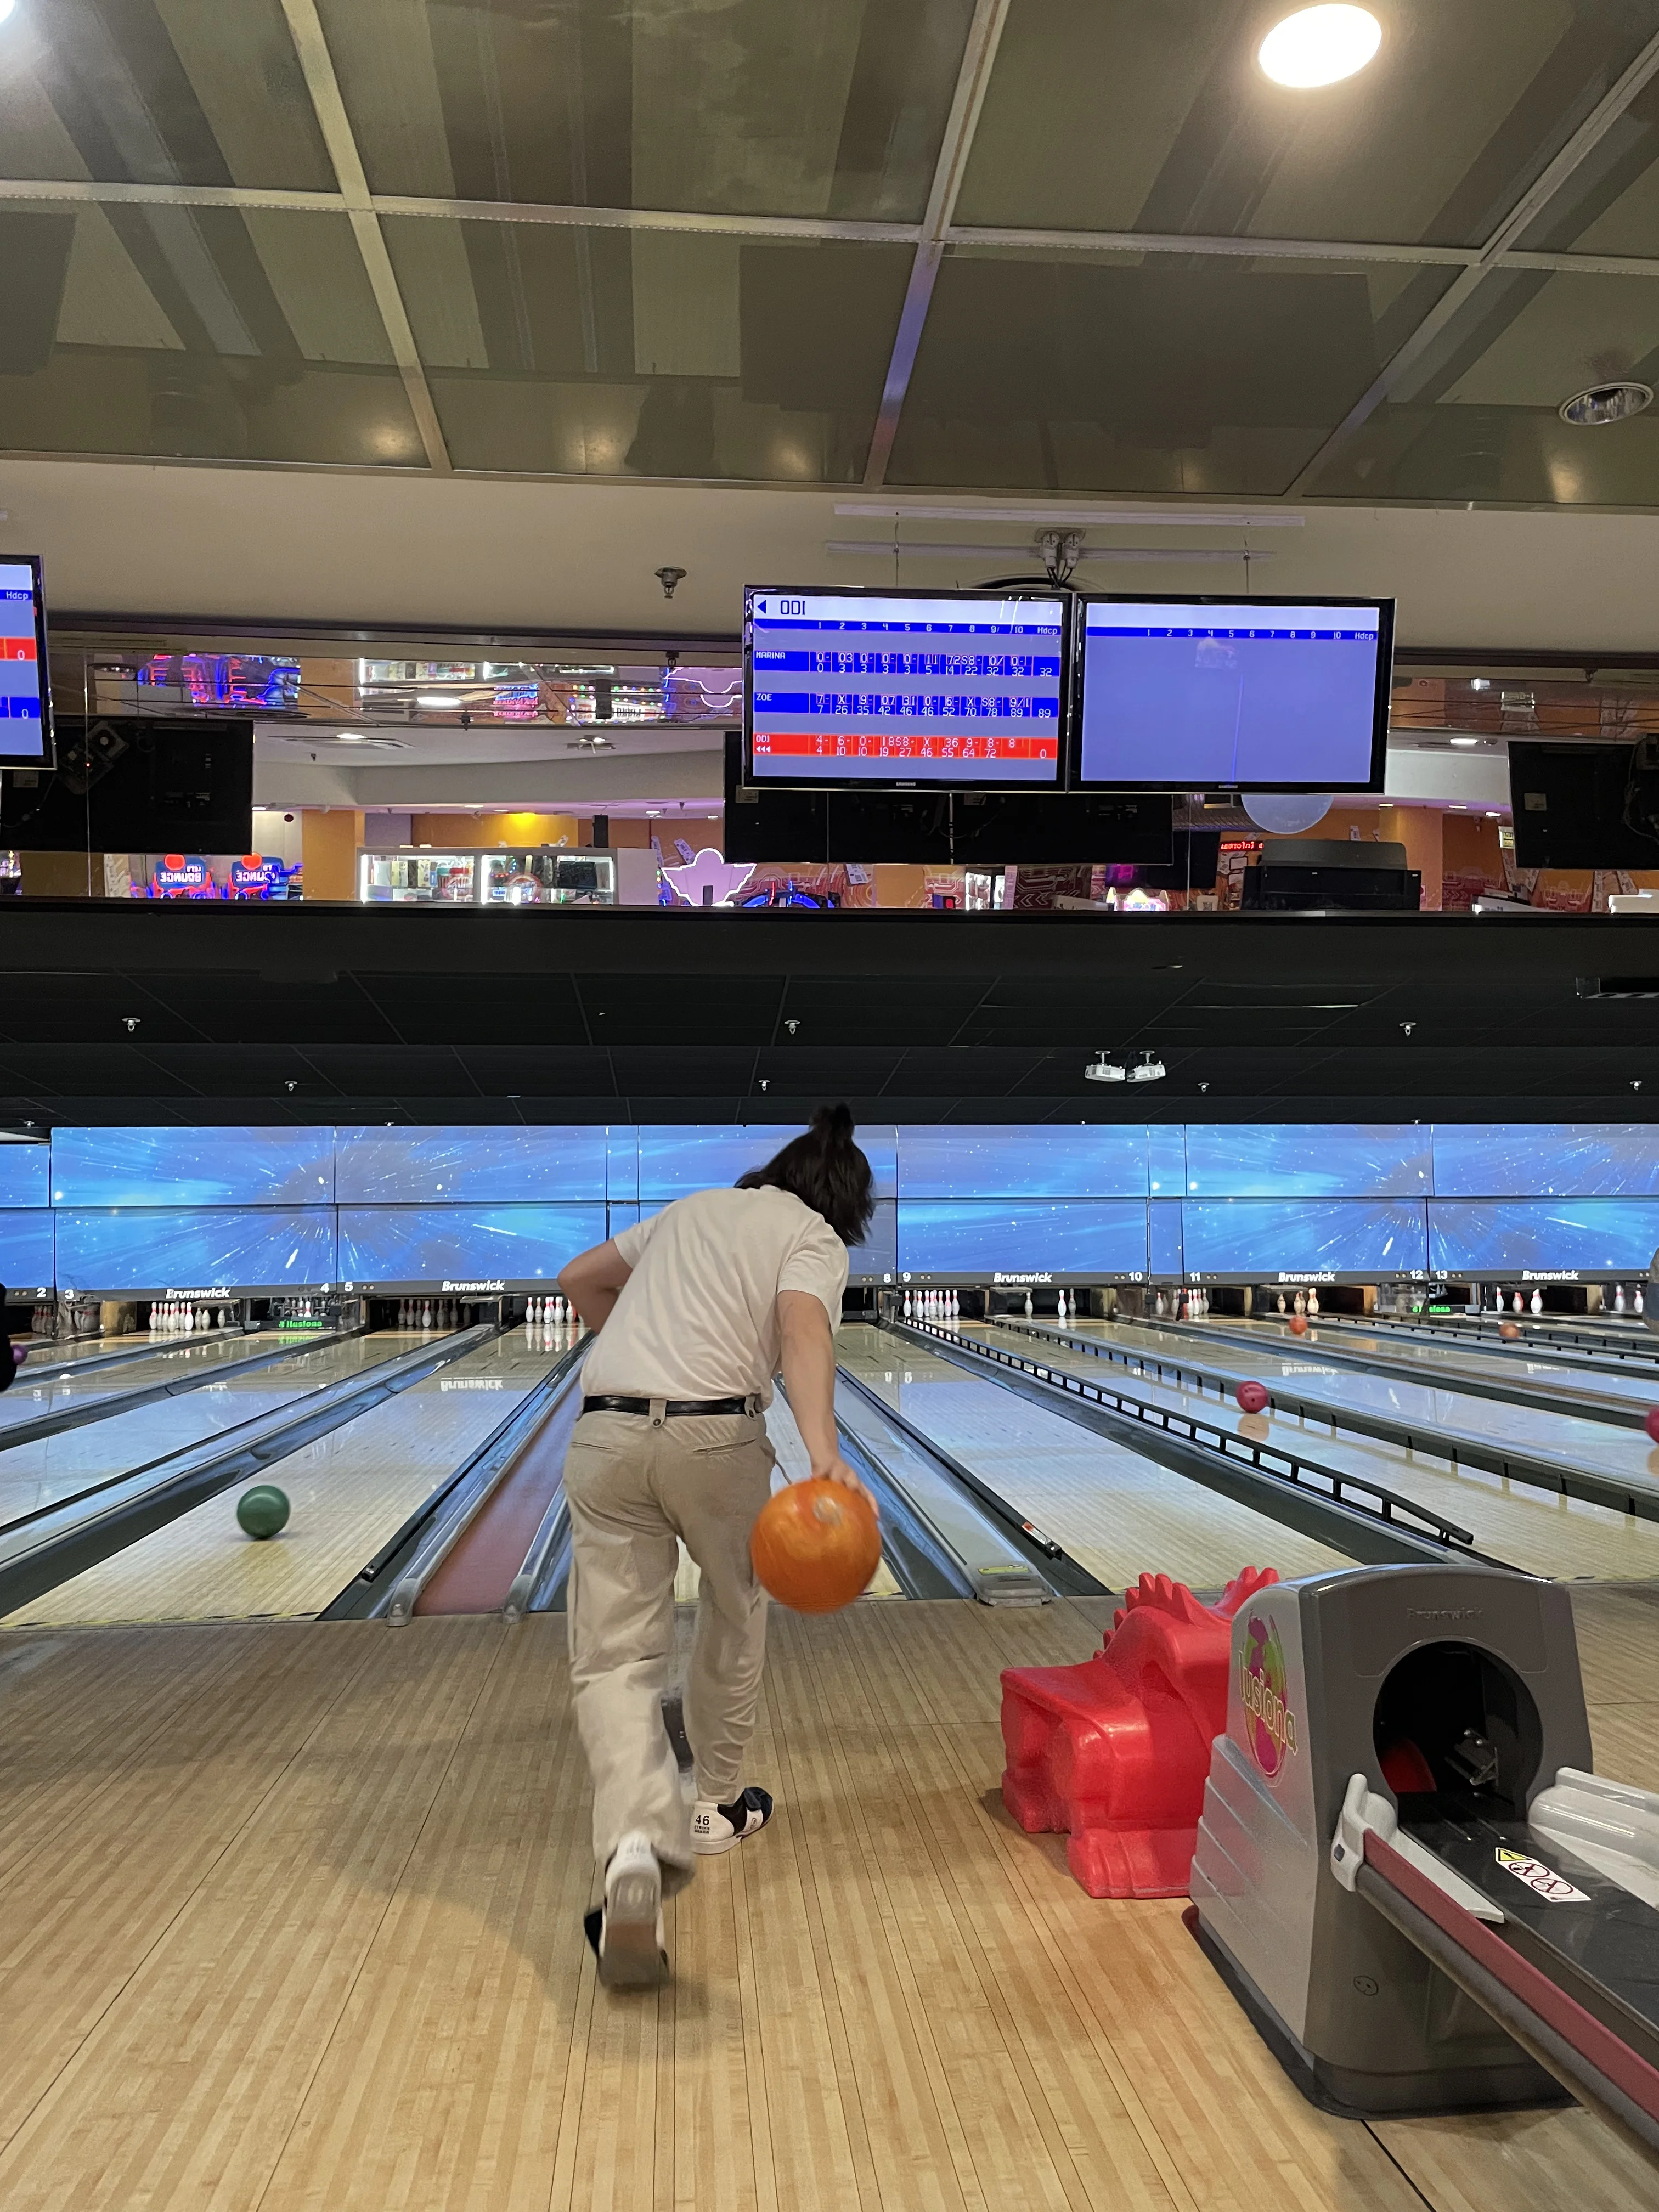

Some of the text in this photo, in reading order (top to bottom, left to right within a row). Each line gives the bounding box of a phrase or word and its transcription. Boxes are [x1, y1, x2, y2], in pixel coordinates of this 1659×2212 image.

[6, 591, 29, 600] Hdcp
[780, 600, 805, 615] ODI
[861, 622, 867, 630] 3
[882, 623, 888, 631] 4
[905, 623, 911, 631] 5
[926, 624, 932, 632] 6
[969, 624, 975, 633] 8
[991, 625, 996, 633] 9
[1015, 625, 1023, 634] 10
[1037, 627, 1058, 636] Hdcp
[1311, 631, 1316, 639] 9
[1355, 632, 1374, 641] Hdcp
[17, 650, 25, 660] 0
[839, 652, 853, 663] 03
[817, 663, 1052, 677] 0 3 3 3 3 5 14 22 32 32 32
[838, 695, 845, 704] X
[882, 695, 895, 705] 07
[967, 697, 974, 707] X
[21, 708, 29, 719] 0
[817, 704, 1051, 718] 7 26 35 42 46 46 52 70 78 89 89
[924, 737, 930, 747] X
[945, 737, 958, 747] 36
[1009, 738, 1015, 748] 8
[816, 746, 1047, 759] 4 10 10 19 27 46 55 64 72 0
[883, 1273, 891, 1283] 8
[902, 1272, 911, 1282] 9
[994, 1271, 1052, 1283] Brunswick
[1128, 1272, 1143, 1282] 10
[1189, 1272, 1201, 1282] 11
[1278, 1271, 1335, 1283] Brunswick
[1409, 1270, 1424, 1280] 12
[1435, 1271, 1448, 1280] 13
[1522, 1269, 1579, 1281] Brunswick
[320, 1283, 329, 1293] 4
[344, 1281, 353, 1291] 5
[442, 1279, 505, 1291] Brunswick
[36, 1287, 47, 1297] 2
[64, 1289, 75, 1299] 3
[166, 1286, 230, 1299] Brunswick
[696, 1815, 709, 1825] 46
